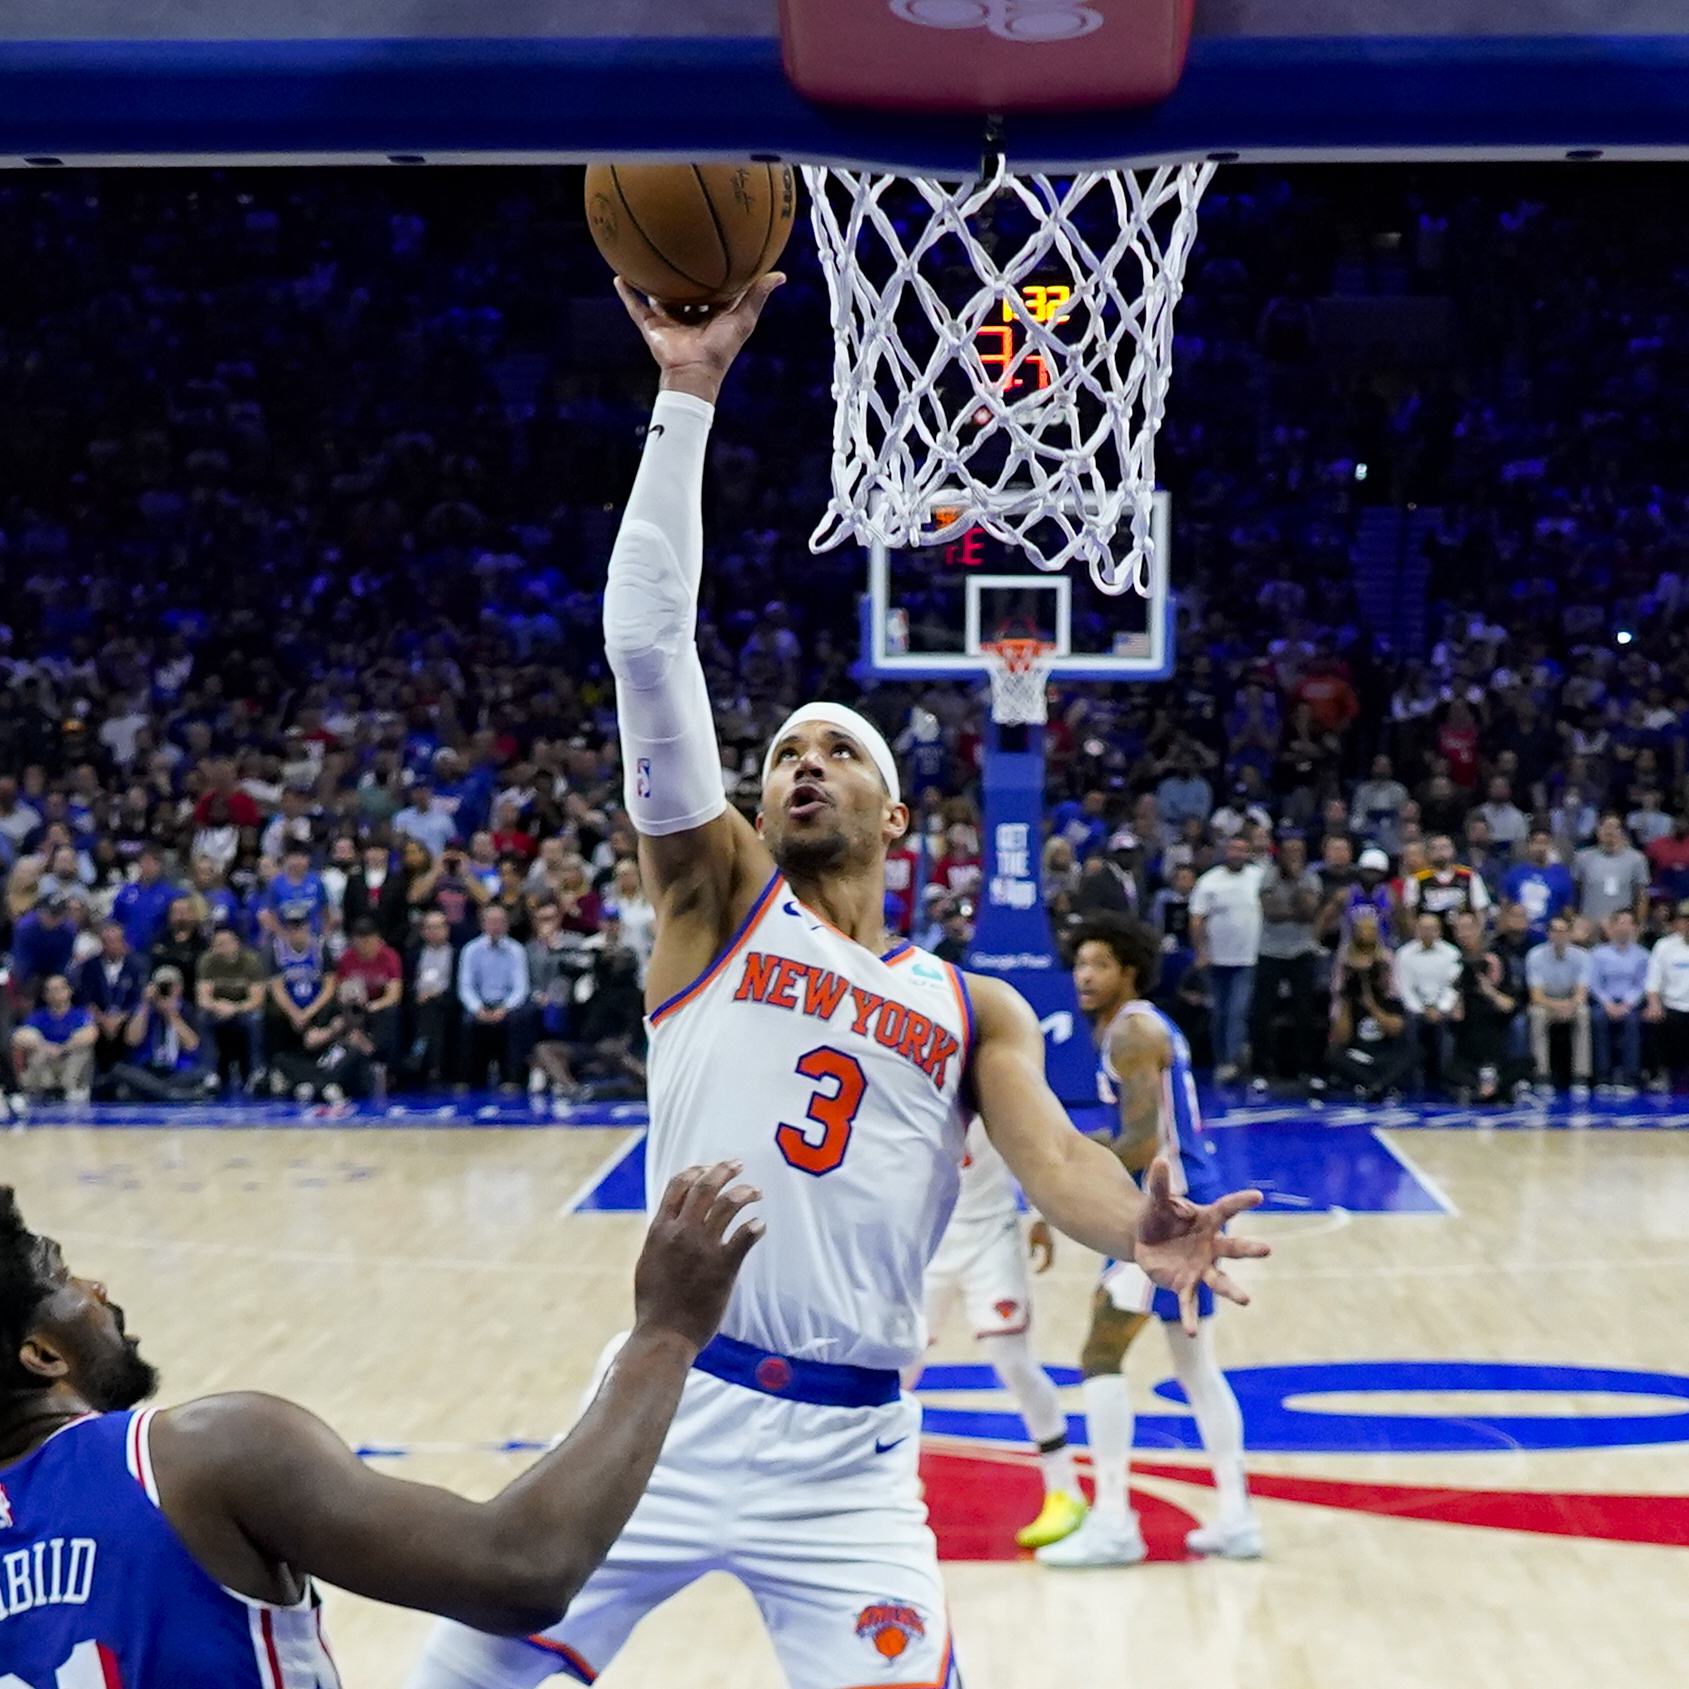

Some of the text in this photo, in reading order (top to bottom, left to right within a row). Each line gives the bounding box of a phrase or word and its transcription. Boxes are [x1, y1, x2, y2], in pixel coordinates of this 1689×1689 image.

[733, 951, 961, 1092] NEW YORK
[775, 1045, 868, 1178] 3
